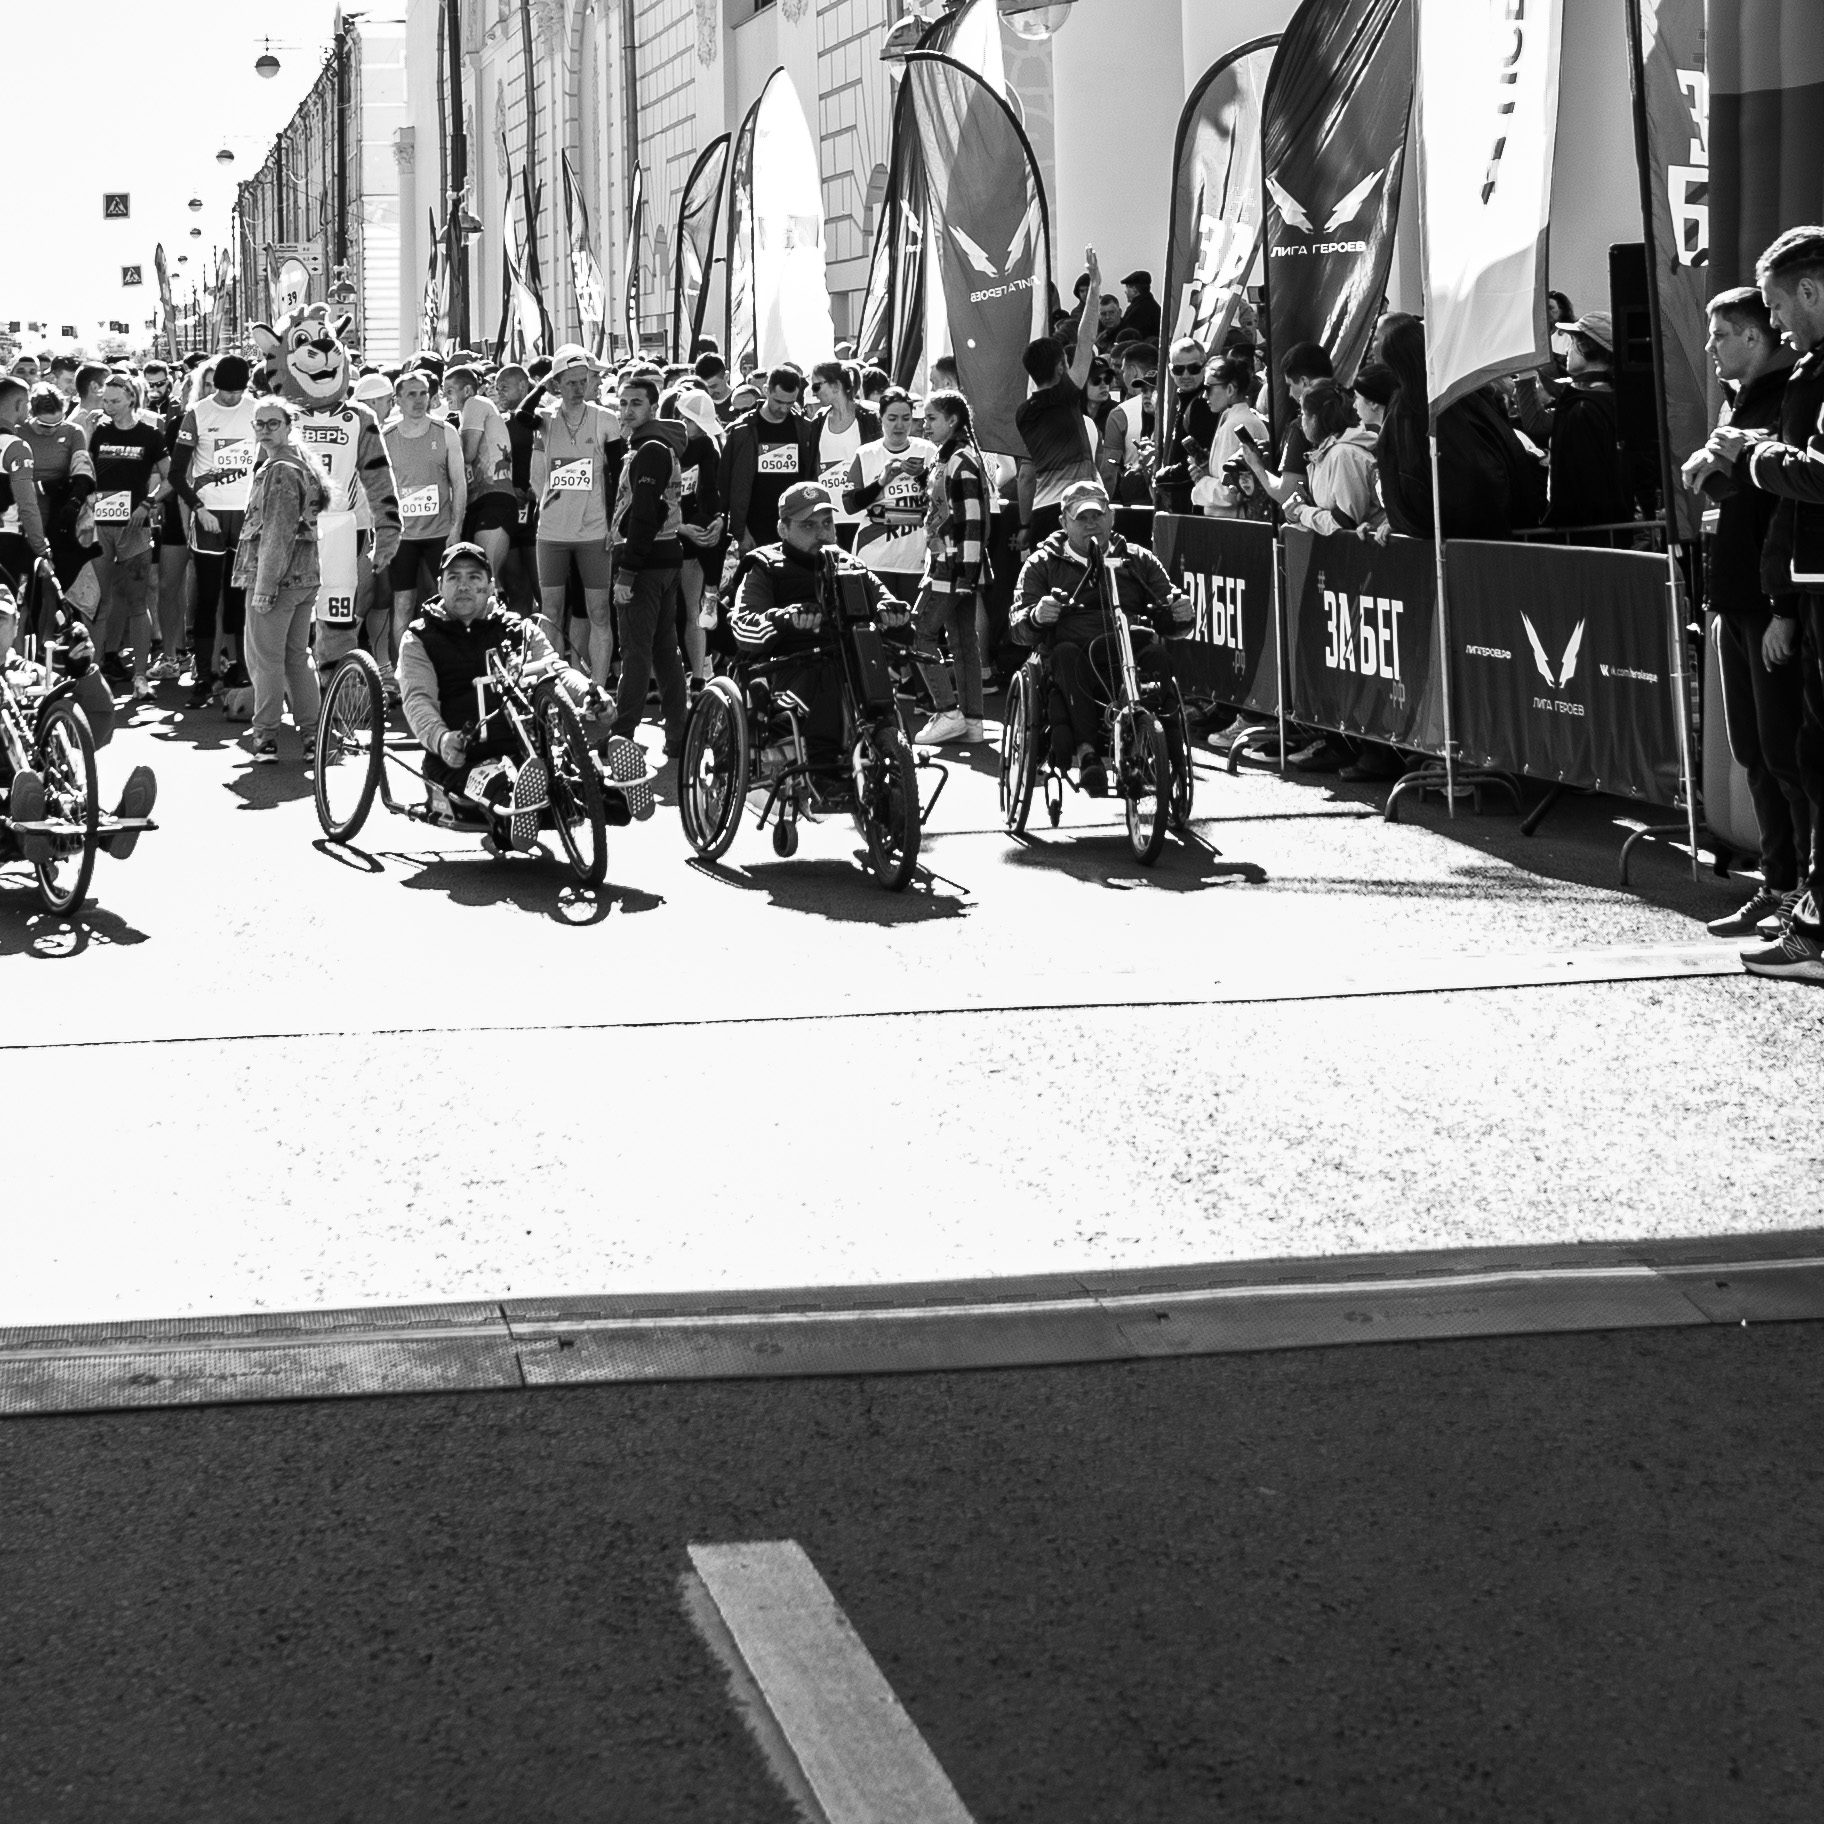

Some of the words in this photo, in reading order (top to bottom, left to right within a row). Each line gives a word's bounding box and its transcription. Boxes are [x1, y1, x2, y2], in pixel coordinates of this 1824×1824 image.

[1270, 244, 1308, 258] ЛИГА
[1312, 240, 1368, 255] ГЕРОЕВ
[305, 428, 349, 445] ВЕРЬ
[217, 454, 253, 465] 05196
[761, 460, 797, 470] 05049
[552, 476, 591, 487] 05079
[95, 507, 130, 518] 05006
[402, 502, 438, 513] 00167
[328, 596, 351, 617] 69
[1532, 696, 1554, 711] ЛИГА
[1554, 700, 1585, 716] ГЕРОЕВ
